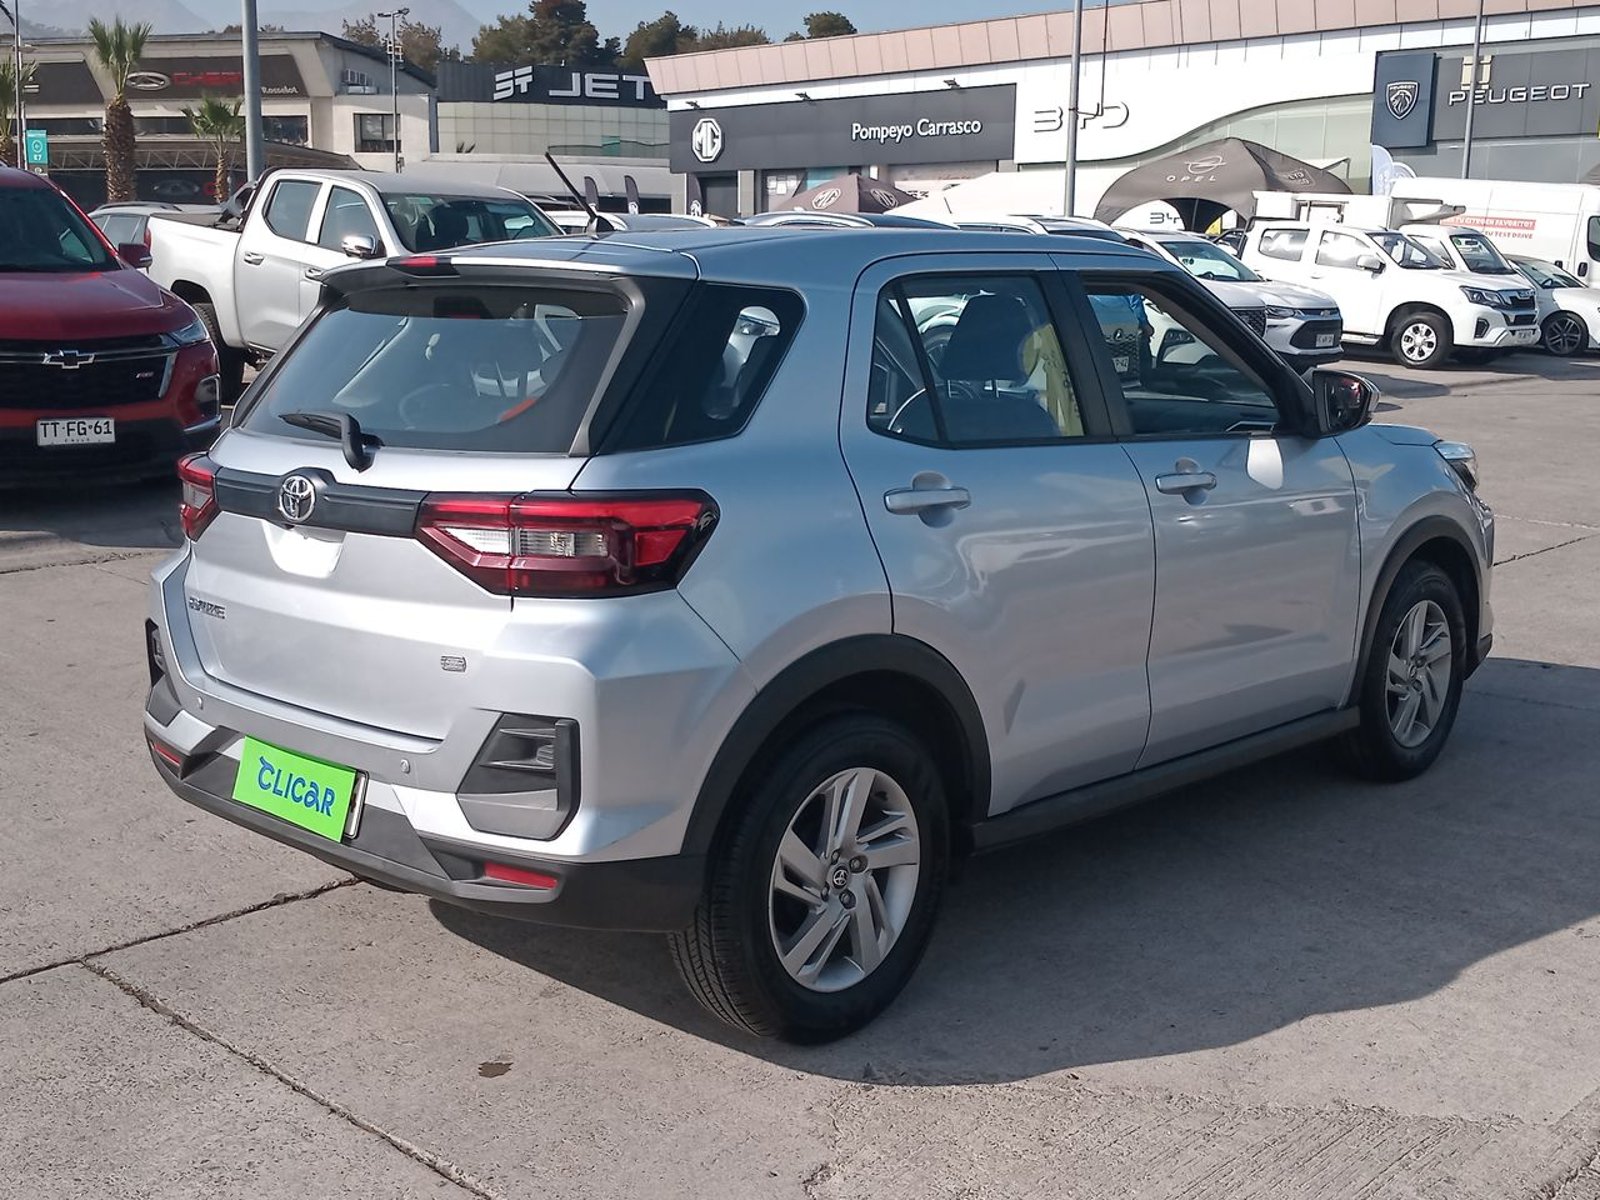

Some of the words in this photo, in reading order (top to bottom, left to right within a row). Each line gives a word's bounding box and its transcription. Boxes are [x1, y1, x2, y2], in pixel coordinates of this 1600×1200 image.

[1448, 83, 1591, 106] PEUGEOT
[1034, 100, 1129, 133] BYD
[693, 118, 721, 161] MG
[852, 122, 913, 144] Pompeyo
[916, 118, 982, 136] Carrasco
[1166, 174, 1217, 183] OPEL
